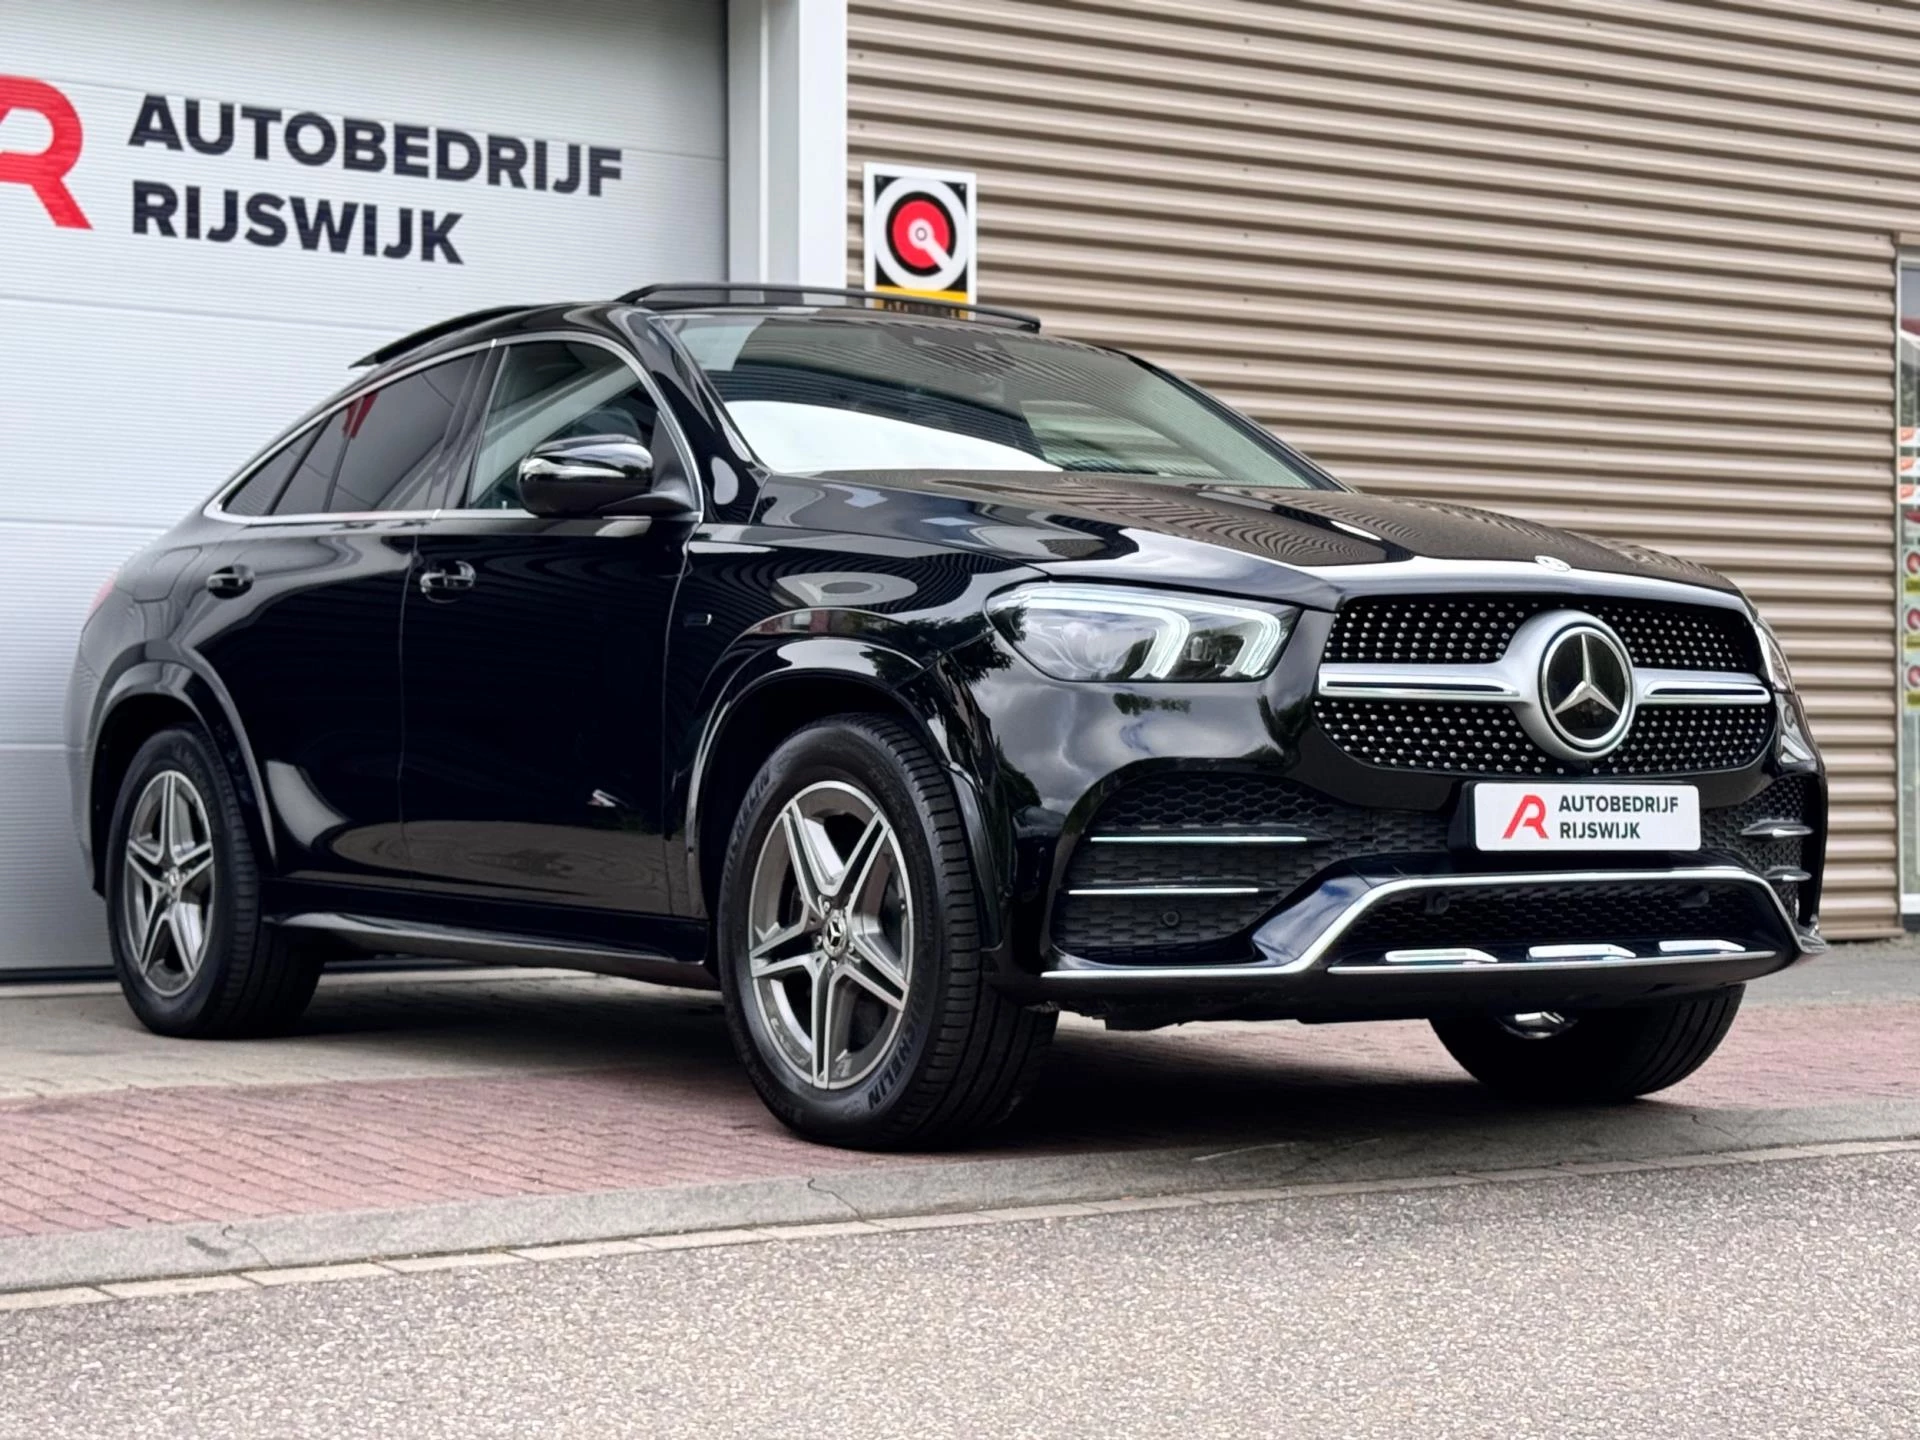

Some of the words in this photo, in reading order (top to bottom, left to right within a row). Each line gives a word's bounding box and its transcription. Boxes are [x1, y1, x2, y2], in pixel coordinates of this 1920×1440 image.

[128, 93, 622, 197] AUTOBEDRIJF
[132, 180, 464, 265] RIJSWIJK
[1558, 795, 1679, 814] AUTOBEDRIJF
[1560, 821, 1641, 839] RIJSWIJK
